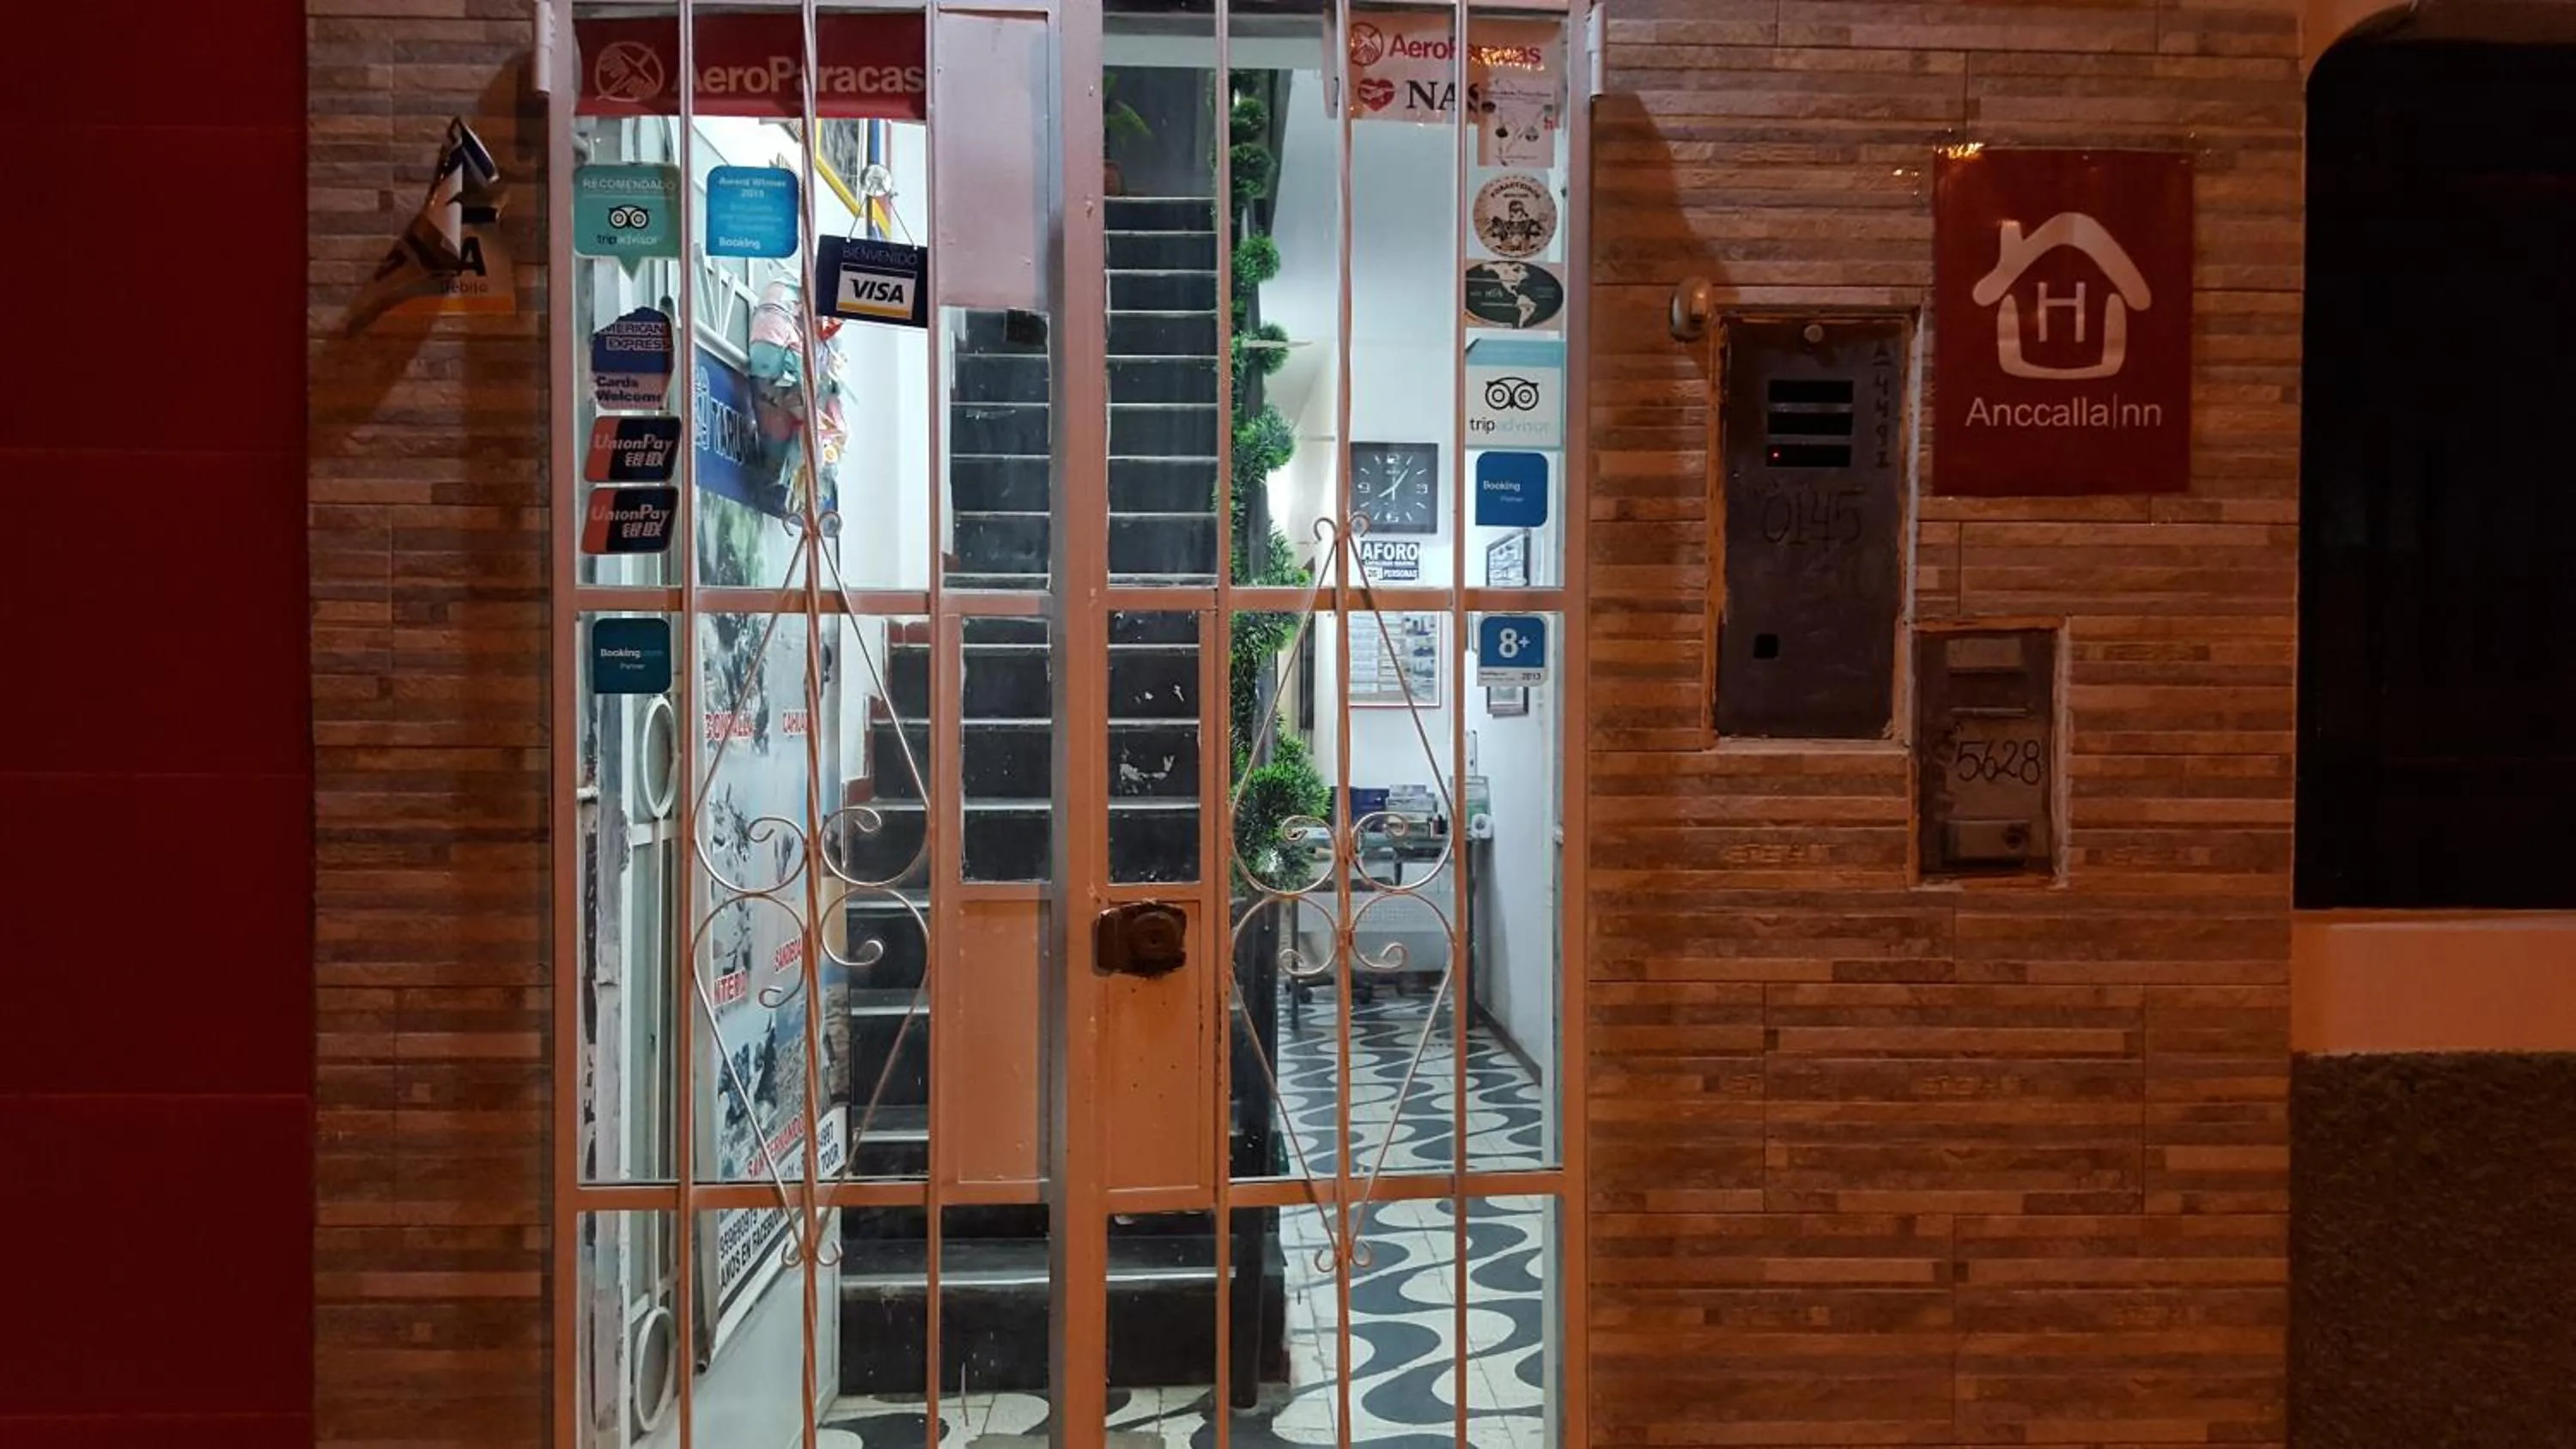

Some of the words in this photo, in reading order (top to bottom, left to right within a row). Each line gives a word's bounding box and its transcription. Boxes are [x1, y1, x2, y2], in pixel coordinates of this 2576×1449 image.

[597, 233, 659, 246] tripadvisor
[719, 237, 762, 251] Booking
[849, 278, 905, 304] VISA
[2037, 281, 2087, 343] H
[596, 375, 640, 389] Cards
[1468, 417, 1551, 434] tripadvisor
[594, 433, 674, 458] UnionPay
[1482, 480, 1522, 493] Booking
[591, 504, 671, 529] UnionPay
[1361, 542, 1419, 561] AFORO
[1955, 738, 2043, 786] 5628
